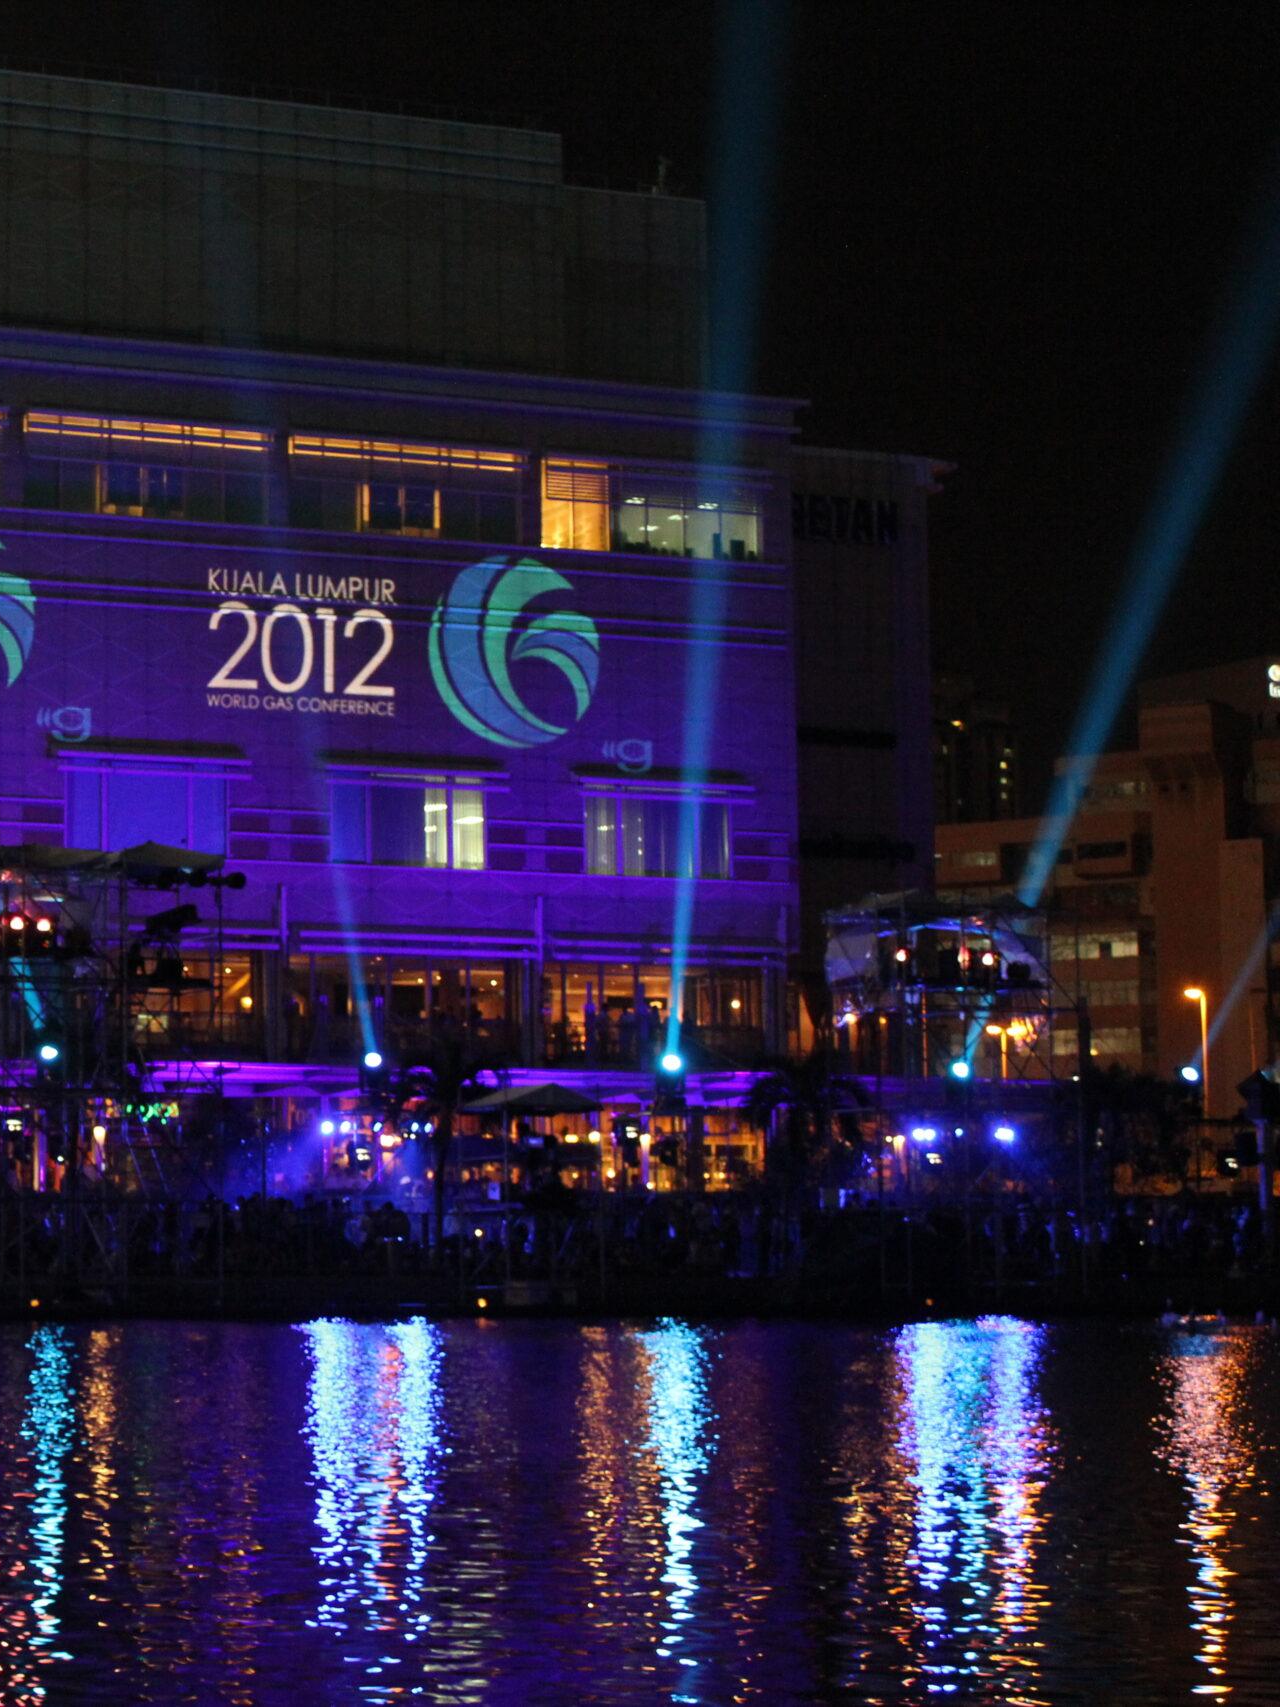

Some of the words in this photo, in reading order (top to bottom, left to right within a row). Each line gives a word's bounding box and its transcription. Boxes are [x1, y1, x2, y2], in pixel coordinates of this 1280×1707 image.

[207, 568, 288, 597] KUALA
[295, 573, 397, 605] LUMPUR
[207, 601, 395, 696] 2012
[206, 693, 260, 710] WORLD
[263, 696, 293, 711] GAS
[297, 697, 395, 716] CONFERENCE
